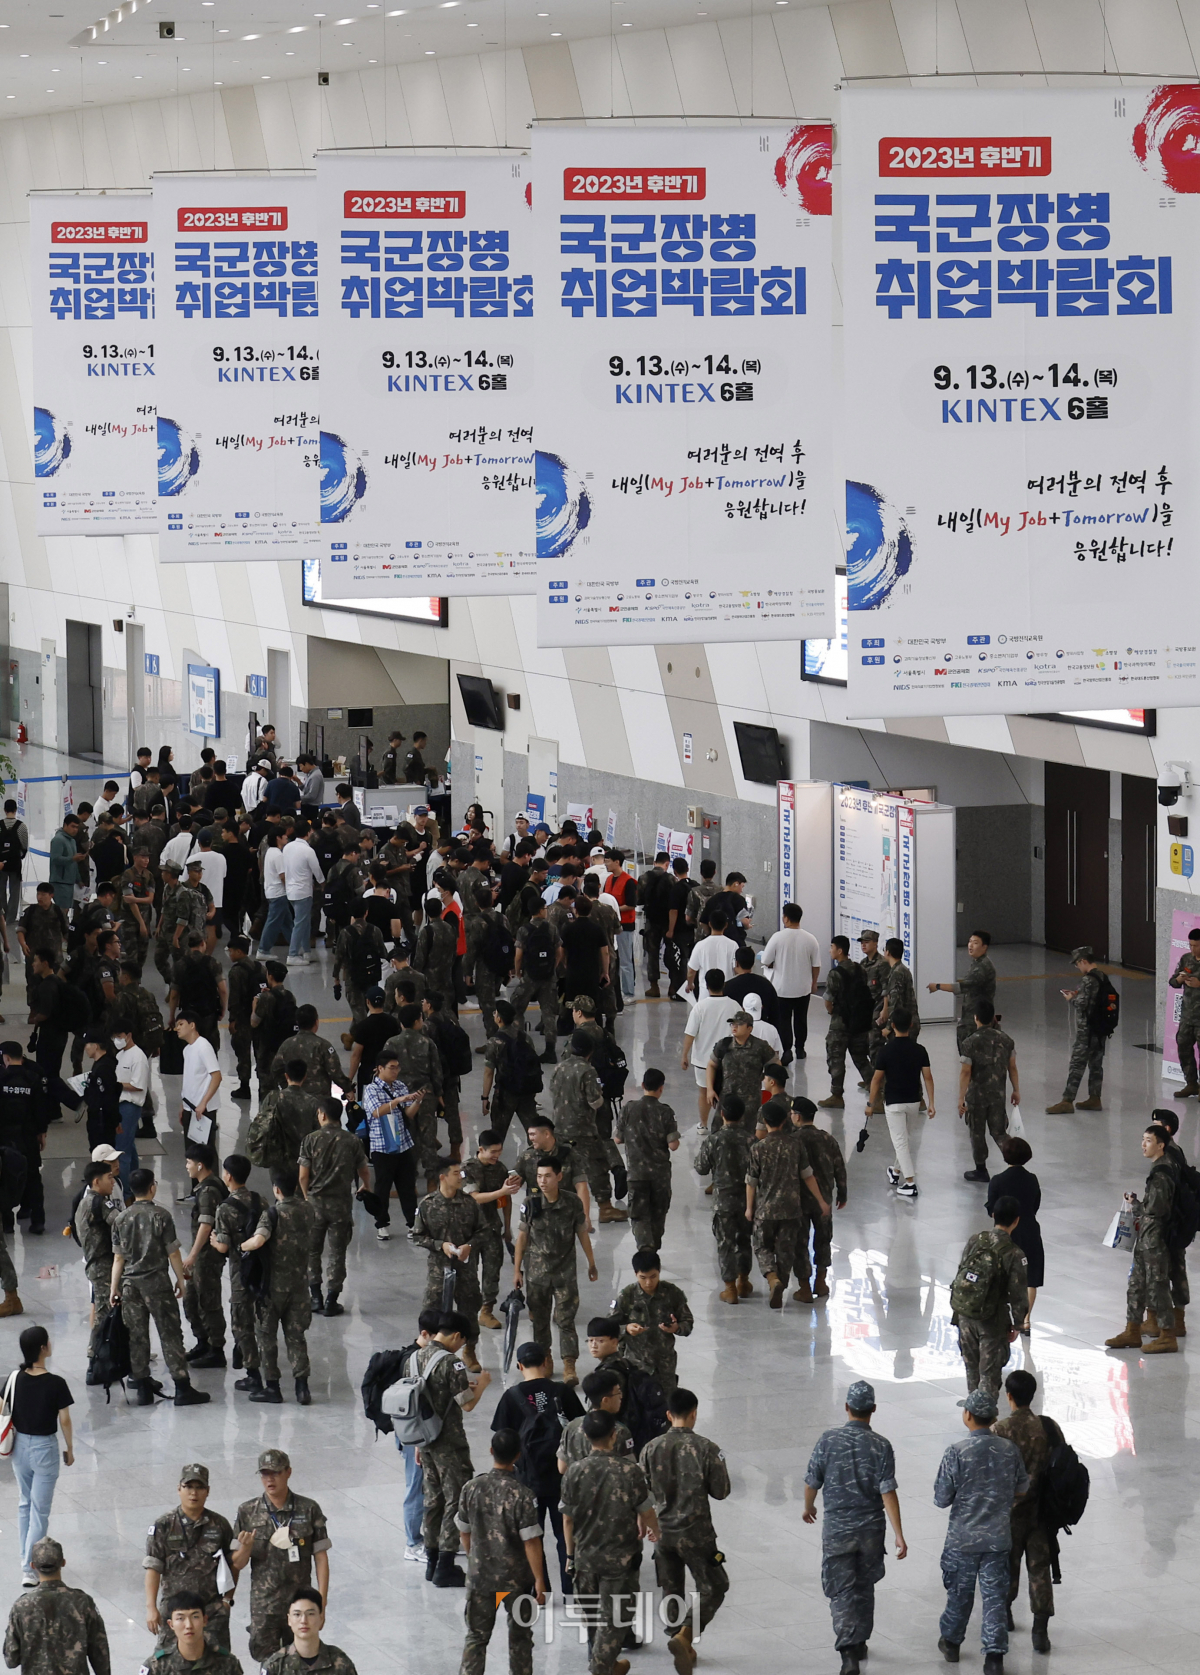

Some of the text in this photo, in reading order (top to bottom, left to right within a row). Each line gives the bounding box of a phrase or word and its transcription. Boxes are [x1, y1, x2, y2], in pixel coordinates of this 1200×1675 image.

[889, 145, 1042, 169] 2023년 후반기
[572, 174, 698, 194] 2023년 후반기
[351, 197, 459, 213] 2023년 후반기
[184, 212, 282, 227] 2023년 후반기
[874, 192, 1110, 253] 국군장병
[57, 226, 143, 239] 2023년 후반기
[559, 213, 756, 263] 국군장병
[341, 230, 509, 272] 국군장병
[49, 252, 155, 284] 국군장
[560, 265, 807, 318] 취업박람회
[875, 255, 1172, 319] 취업박람회
[50, 287, 155, 320] 취업박
[88, 362, 156, 376] KINTEX
[218, 366, 296, 382] KINTEX
[388, 373, 507, 392] KINTEX 6홀
[616, 381, 754, 403] KINTEX 6홀
[136, 405, 157, 415] 여러
[274, 411, 320, 428] 여러분의
[942, 396, 1109, 423] KINTEX 6홀
[267, 436, 320, 449] Job+Tom
[449, 426, 533, 445] 여러분의 전역
[687, 439, 806, 465] 여러분의 전역 후
[482, 473, 536, 492] 응원합니
[1027, 465, 1173, 497] 여러분의 전역 후
[724, 498, 807, 520] 응원합니다!
[1074, 537, 1174, 564] 응원합니다!
